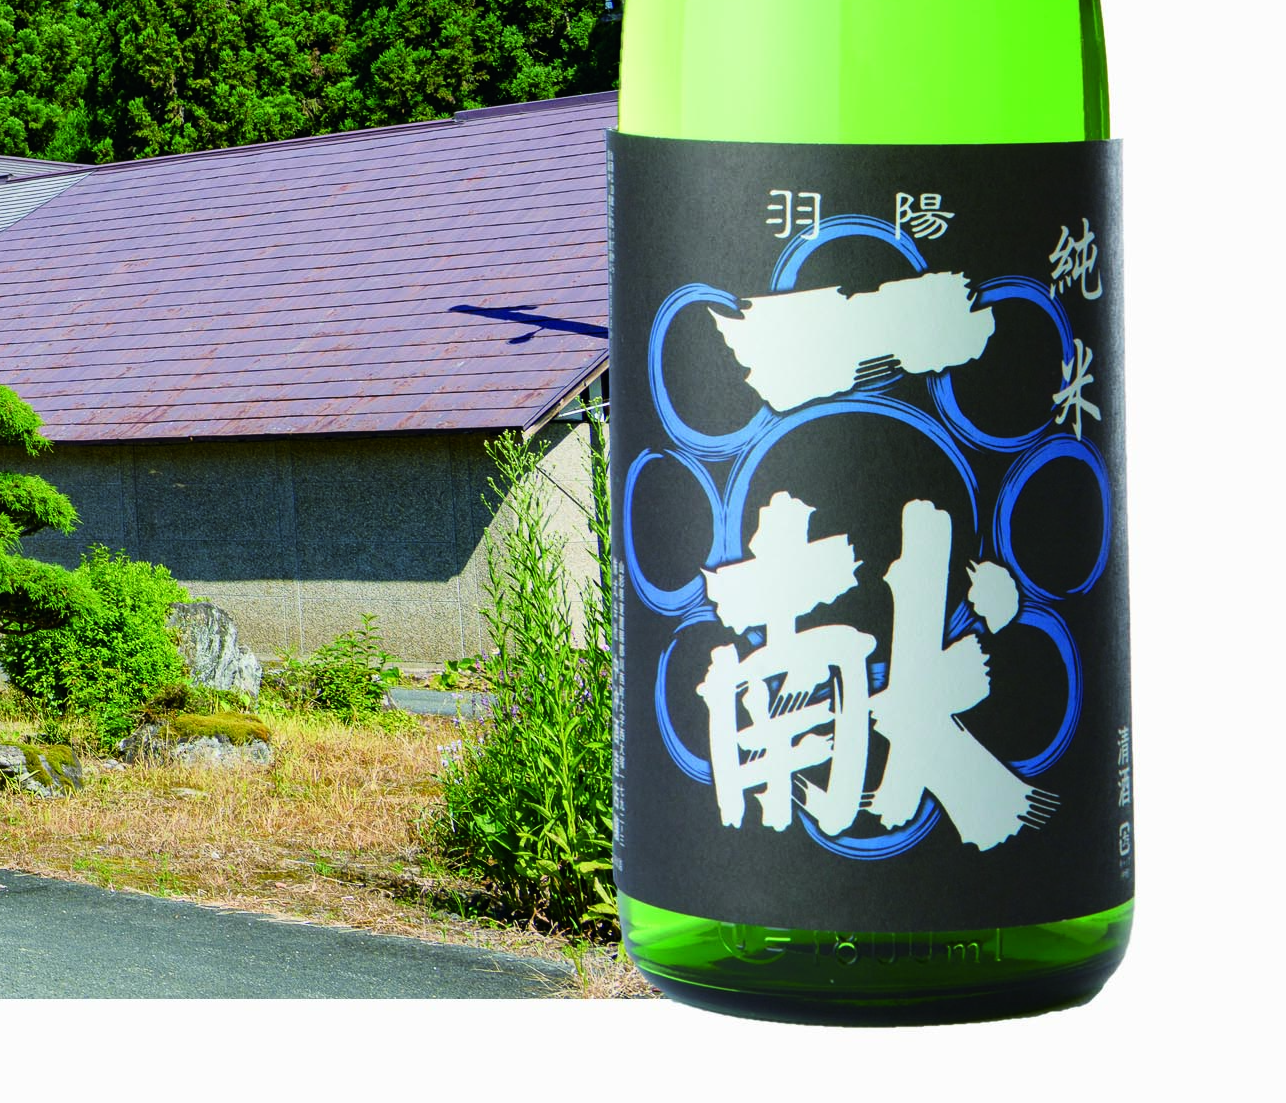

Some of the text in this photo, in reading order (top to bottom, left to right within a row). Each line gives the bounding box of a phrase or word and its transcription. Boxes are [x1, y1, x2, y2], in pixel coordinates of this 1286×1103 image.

[765, 189, 955, 240] 羽陽
[1047, 217, 1103, 441] 純米
[695, 270, 1062, 852] 一献
